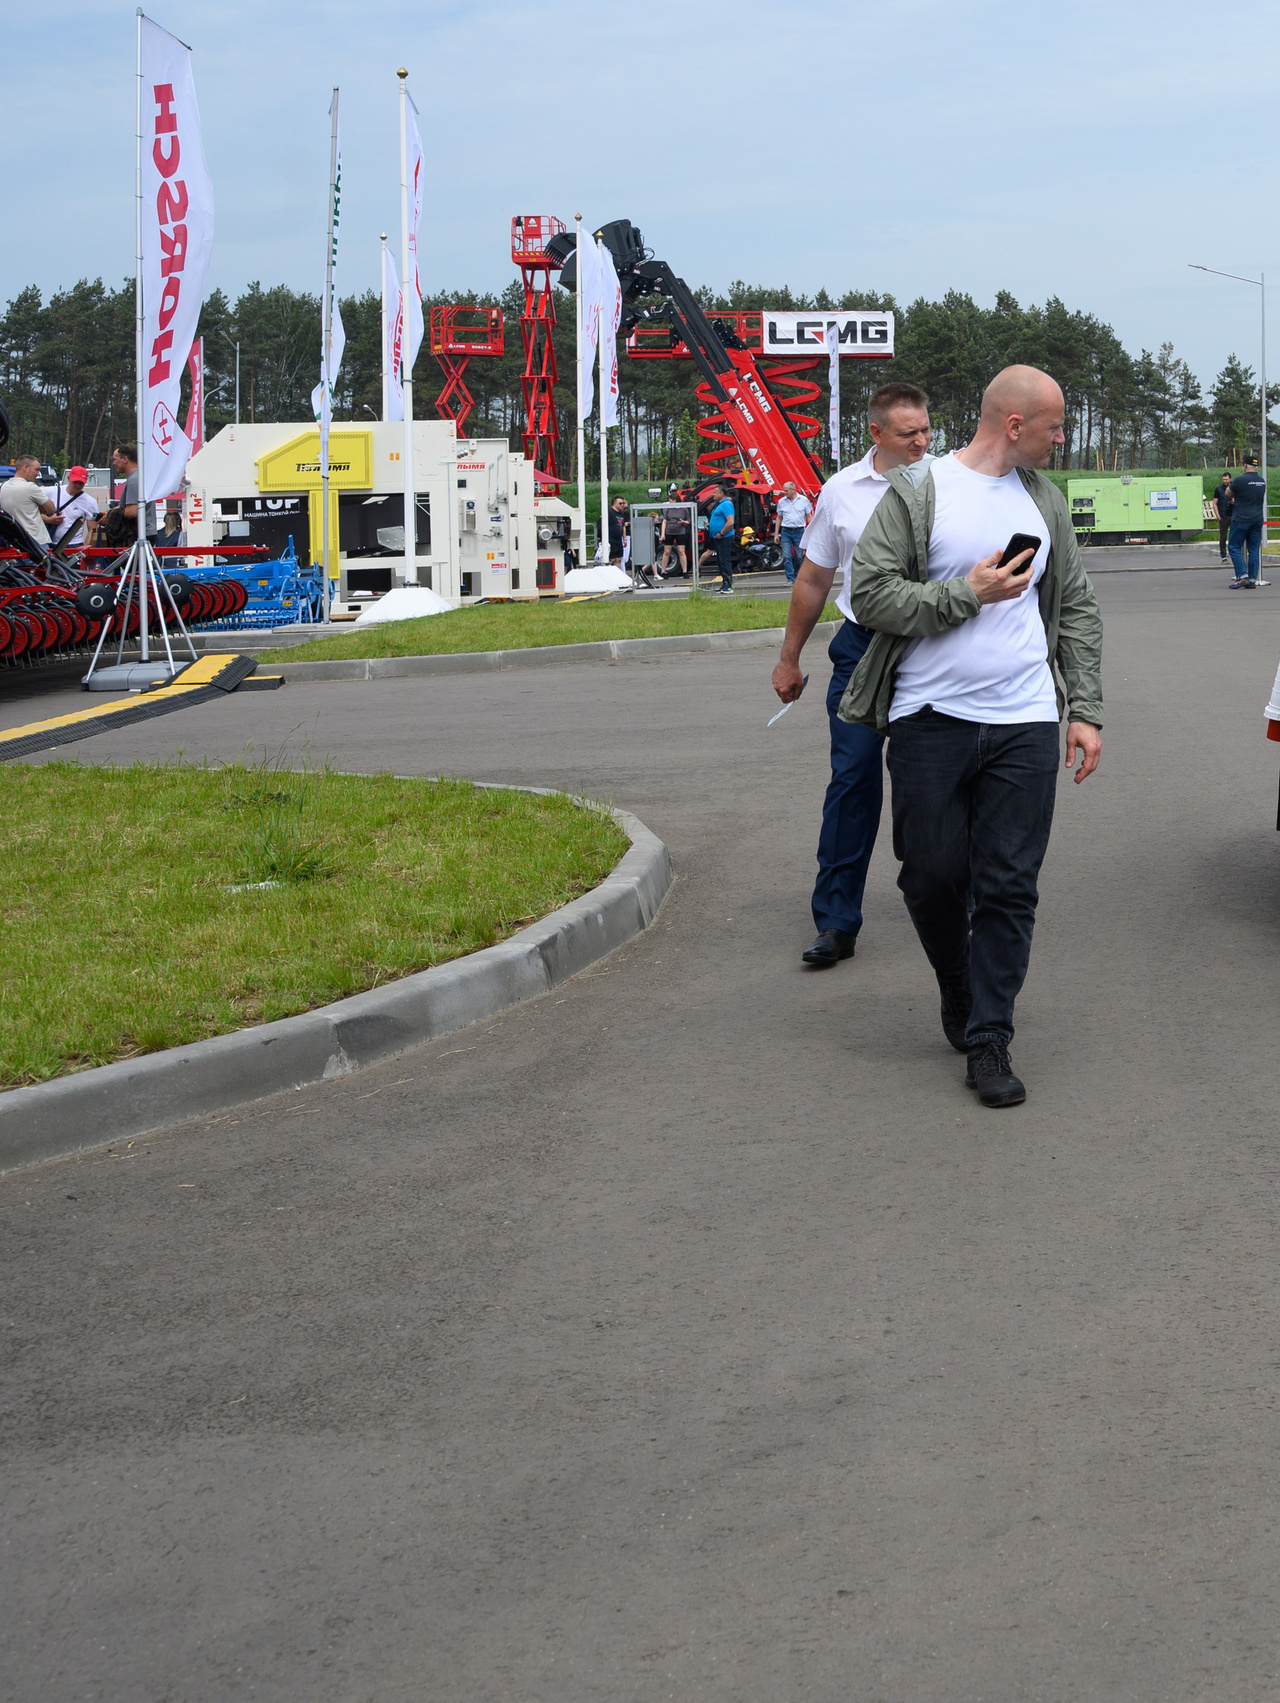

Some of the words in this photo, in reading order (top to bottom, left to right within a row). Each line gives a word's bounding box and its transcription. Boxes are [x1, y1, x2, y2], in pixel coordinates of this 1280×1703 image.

[768, 320, 888, 344] LGMG
[742, 372, 772, 413] LGMG
[735, 397, 755, 424] LGMG
[755, 457, 775, 486] LGMG
[189, 511, 202, 524] 11
